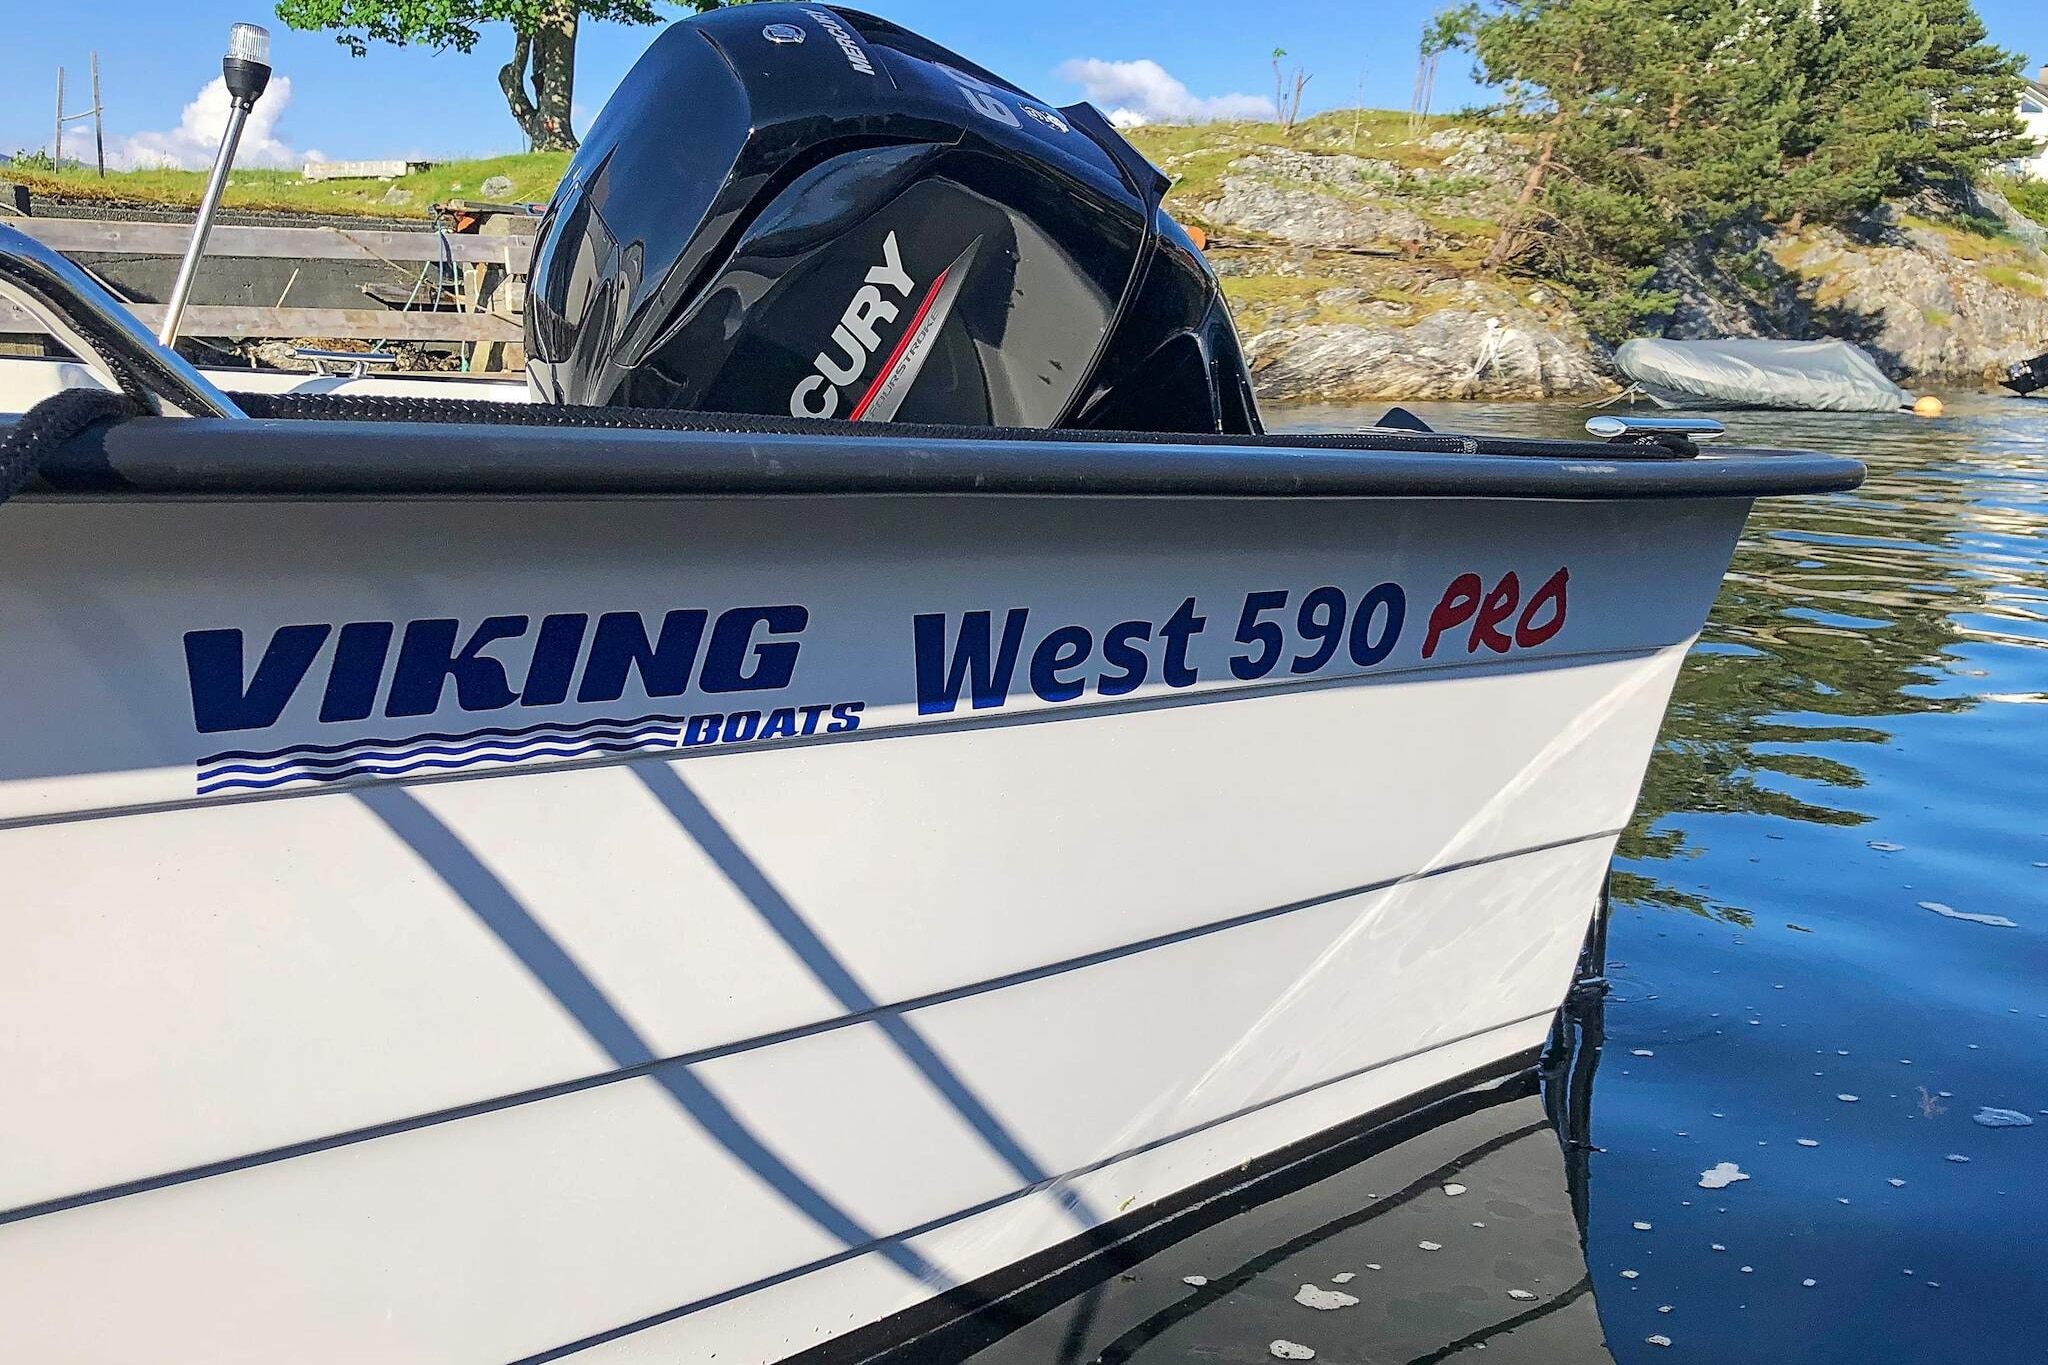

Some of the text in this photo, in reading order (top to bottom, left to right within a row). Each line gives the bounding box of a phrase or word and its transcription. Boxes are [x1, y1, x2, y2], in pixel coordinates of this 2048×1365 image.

[800, 8, 876, 76] MERCURY
[790, 230, 915, 418] CURY
[182, 605, 809, 734] VIKING
[913, 566, 1570, 717] West 590 PRO
[682, 701, 866, 747] BOATS
